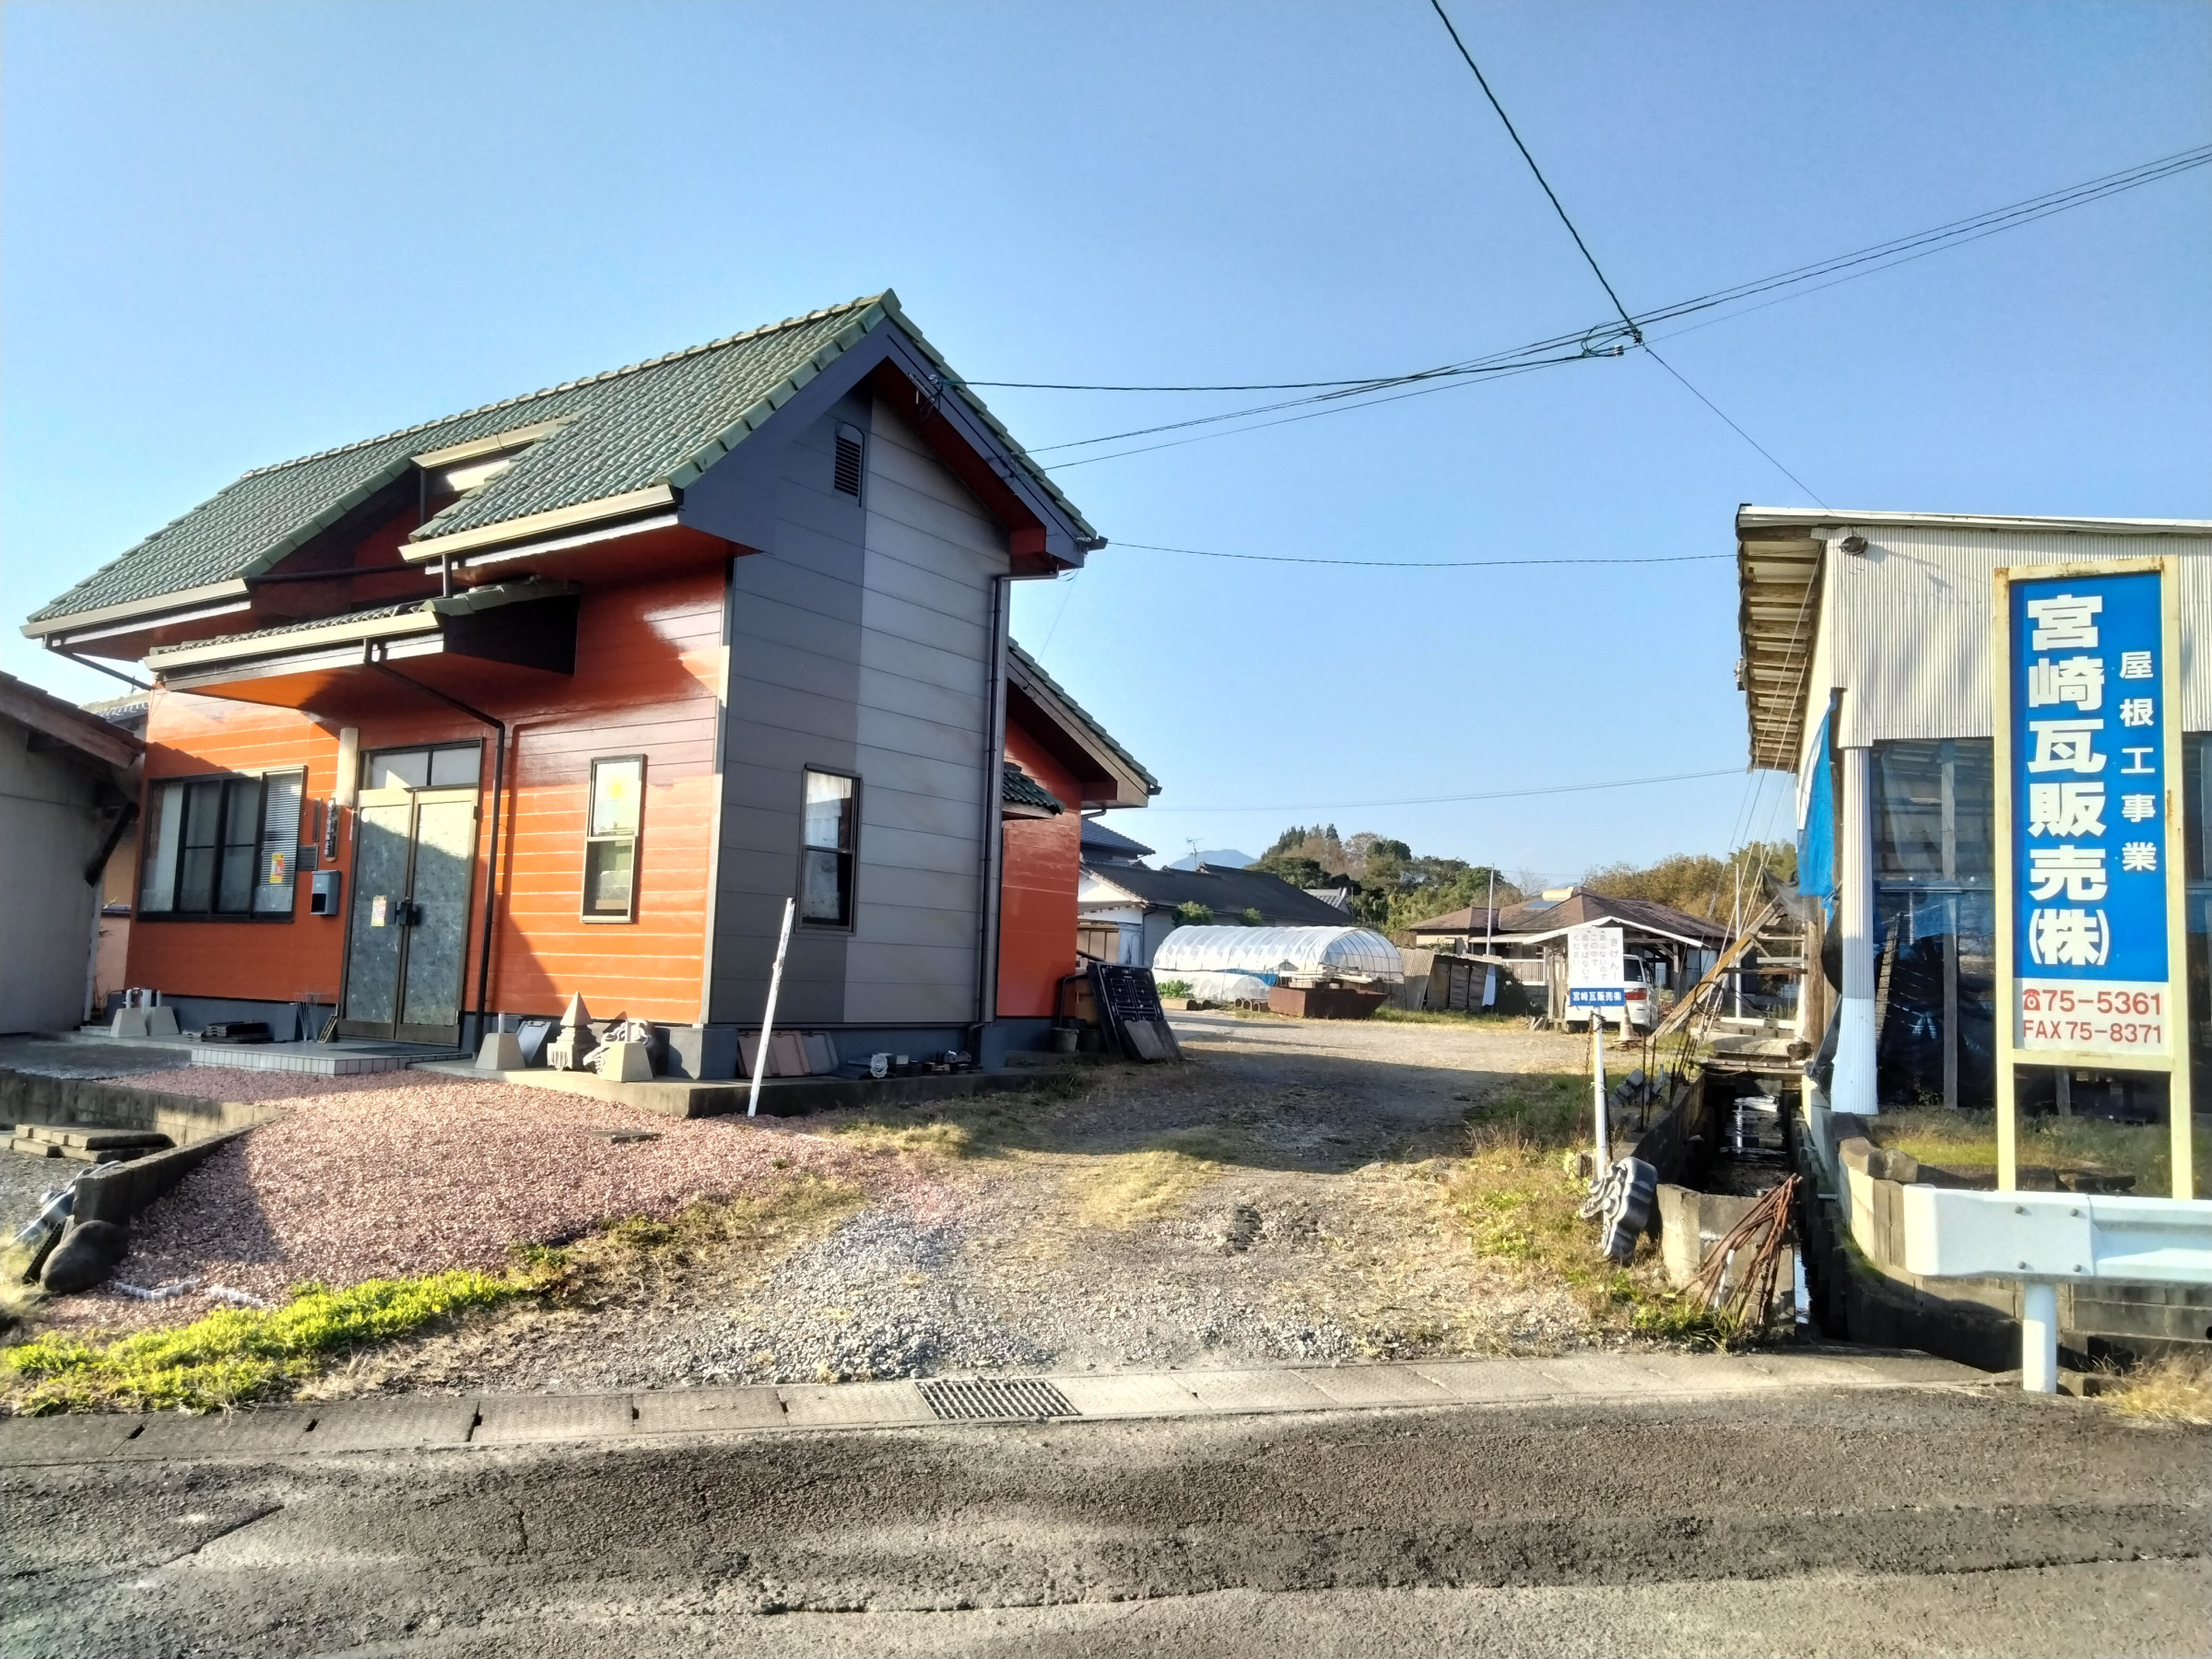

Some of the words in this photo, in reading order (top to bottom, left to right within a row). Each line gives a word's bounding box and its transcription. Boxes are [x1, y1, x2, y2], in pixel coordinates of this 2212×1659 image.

[2120, 651, 2157, 872] 屋根工事業
[2065, 1020, 2161, 1043] 75-8371
